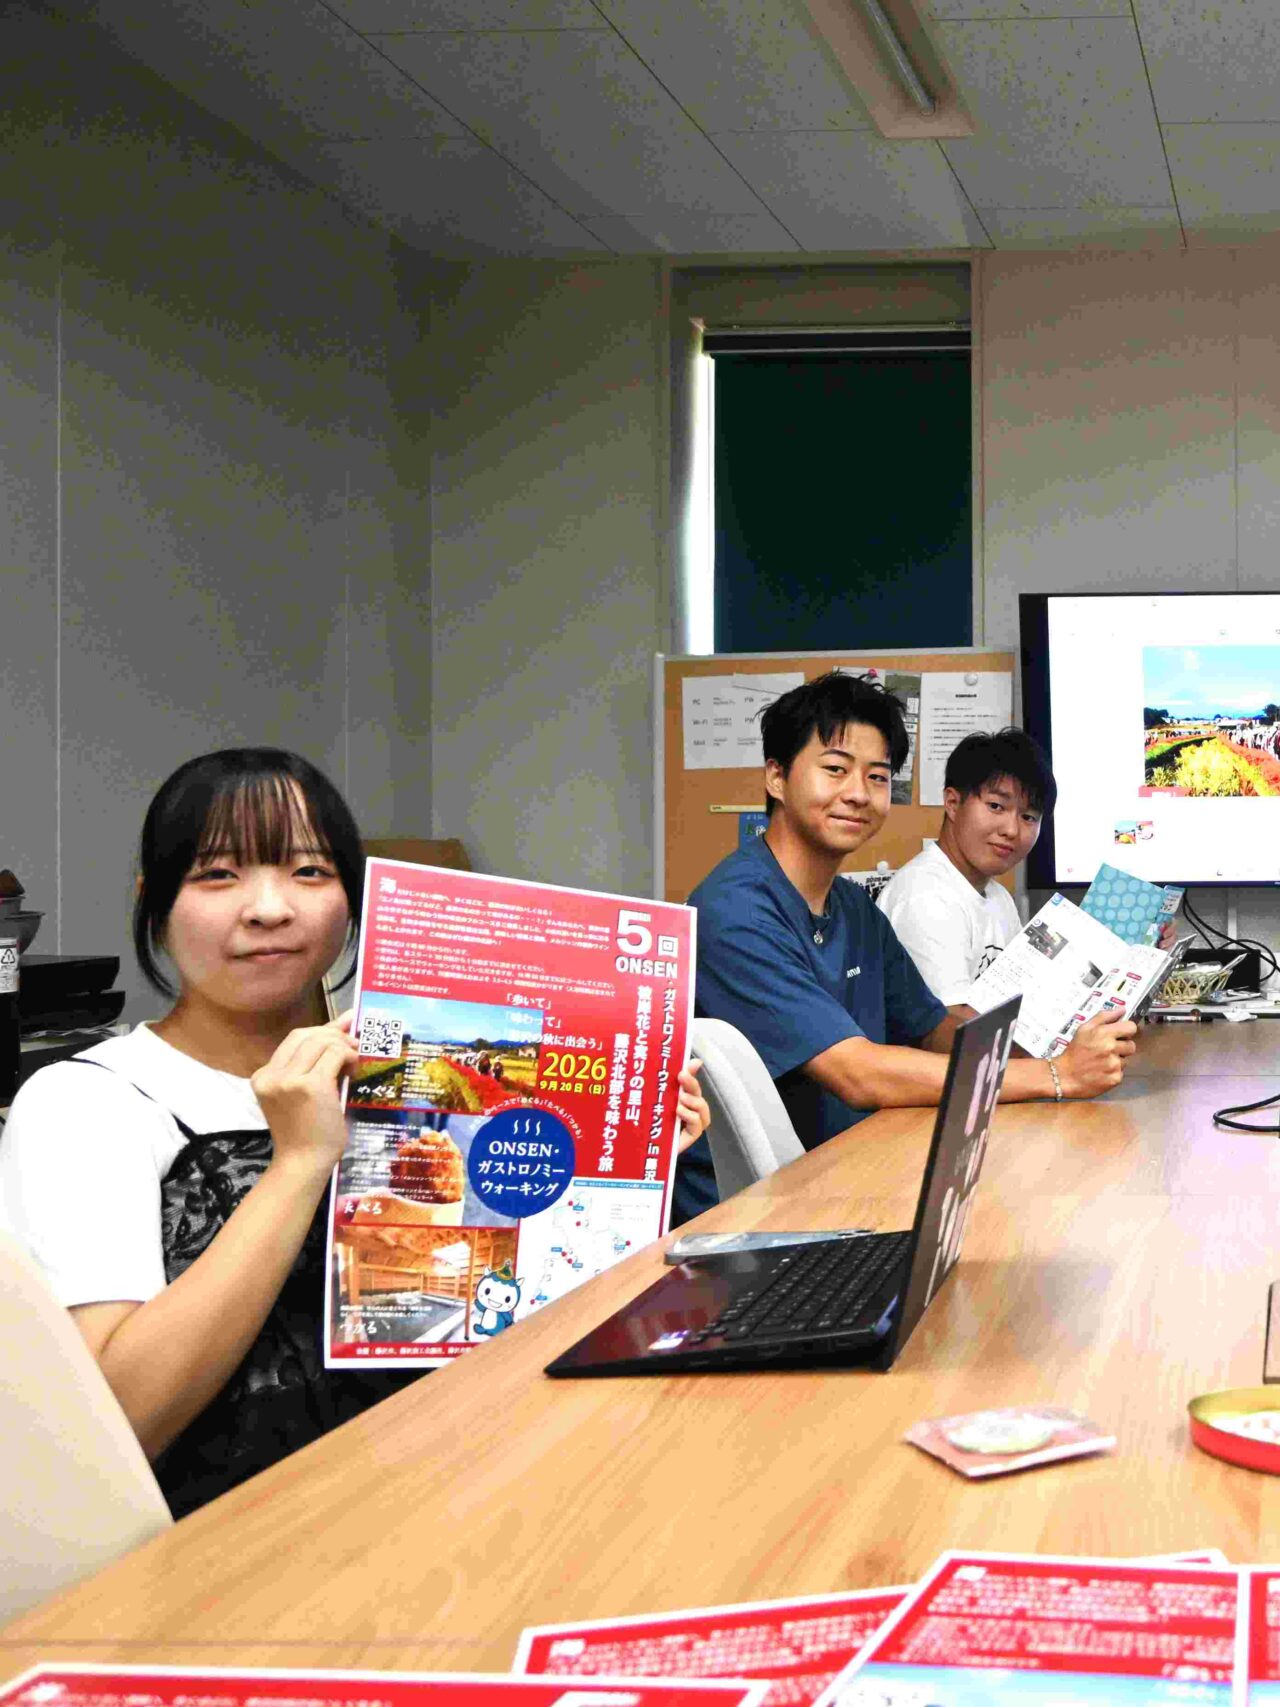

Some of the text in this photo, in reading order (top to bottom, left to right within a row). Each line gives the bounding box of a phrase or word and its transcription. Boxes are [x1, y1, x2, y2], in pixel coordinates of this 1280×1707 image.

[615, 955, 678, 979] ONSEN
[542, 1052, 607, 1081] 2026
[597, 1033, 631, 1172] 藤沢北部を味わう旅
[647, 1142, 660, 1156] in
[477, 1160, 566, 1178] ガストロノミー
[481, 1180, 560, 1197] ウォーキング
